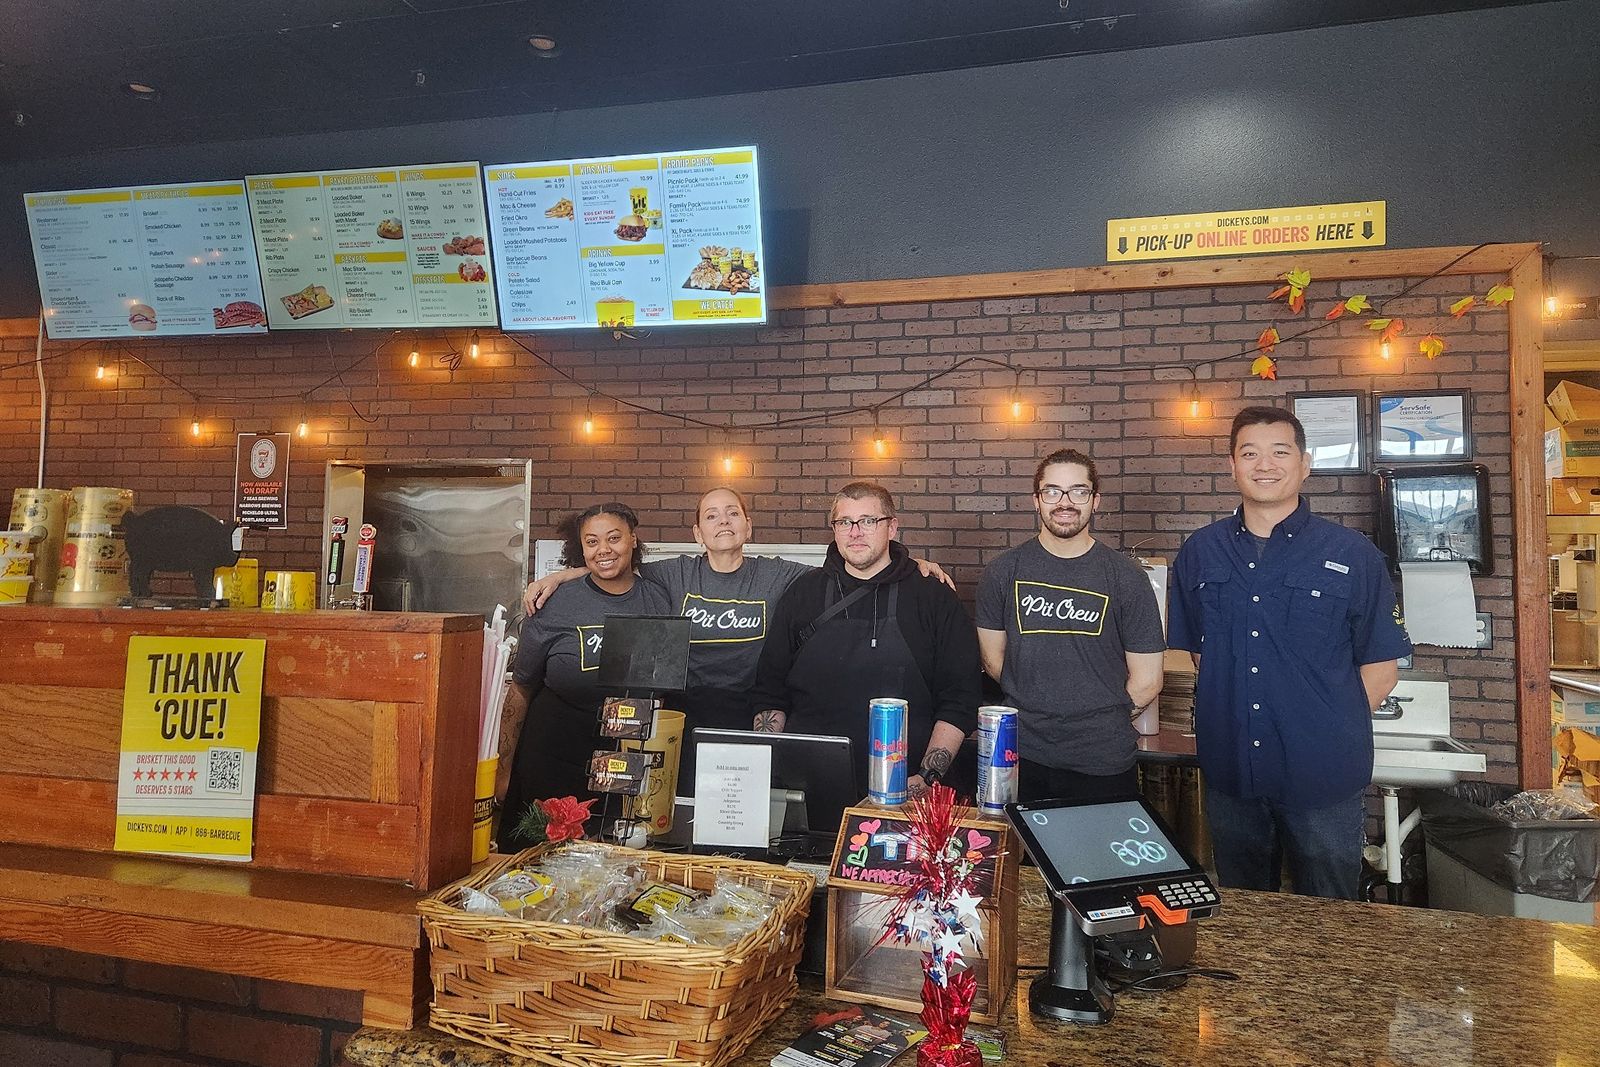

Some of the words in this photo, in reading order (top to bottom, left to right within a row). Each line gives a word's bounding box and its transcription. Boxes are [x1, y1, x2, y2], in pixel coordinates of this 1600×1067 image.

[1217, 216, 1269, 227] DICKEYS.COM
[1136, 234, 1193, 252] PICK-UP
[1197, 230, 1248, 248] ONLINE
[1253, 226, 1309, 245] ORDERS
[1315, 223, 1355, 241] HERE
[1021, 594, 1054, 617] Pit
[1056, 598, 1100, 623] Crew
[685, 607, 714, 628] Pit
[717, 608, 761, 629] Crew
[147, 651, 244, 694] THANK
[874, 739, 896, 751] Red
[136, 754, 163, 764] BRISKET
[163, 754, 177, 764] THIS
[178, 755, 196, 765] GOOD
[135, 785, 168, 795] DESERVES
[168, 785, 173, 794] 5
[174, 785, 193, 795] STARS
[127, 822, 168, 834] DICKEYS.COM
[175, 827, 188, 836] APP
[842, 864, 859, 880] WE
